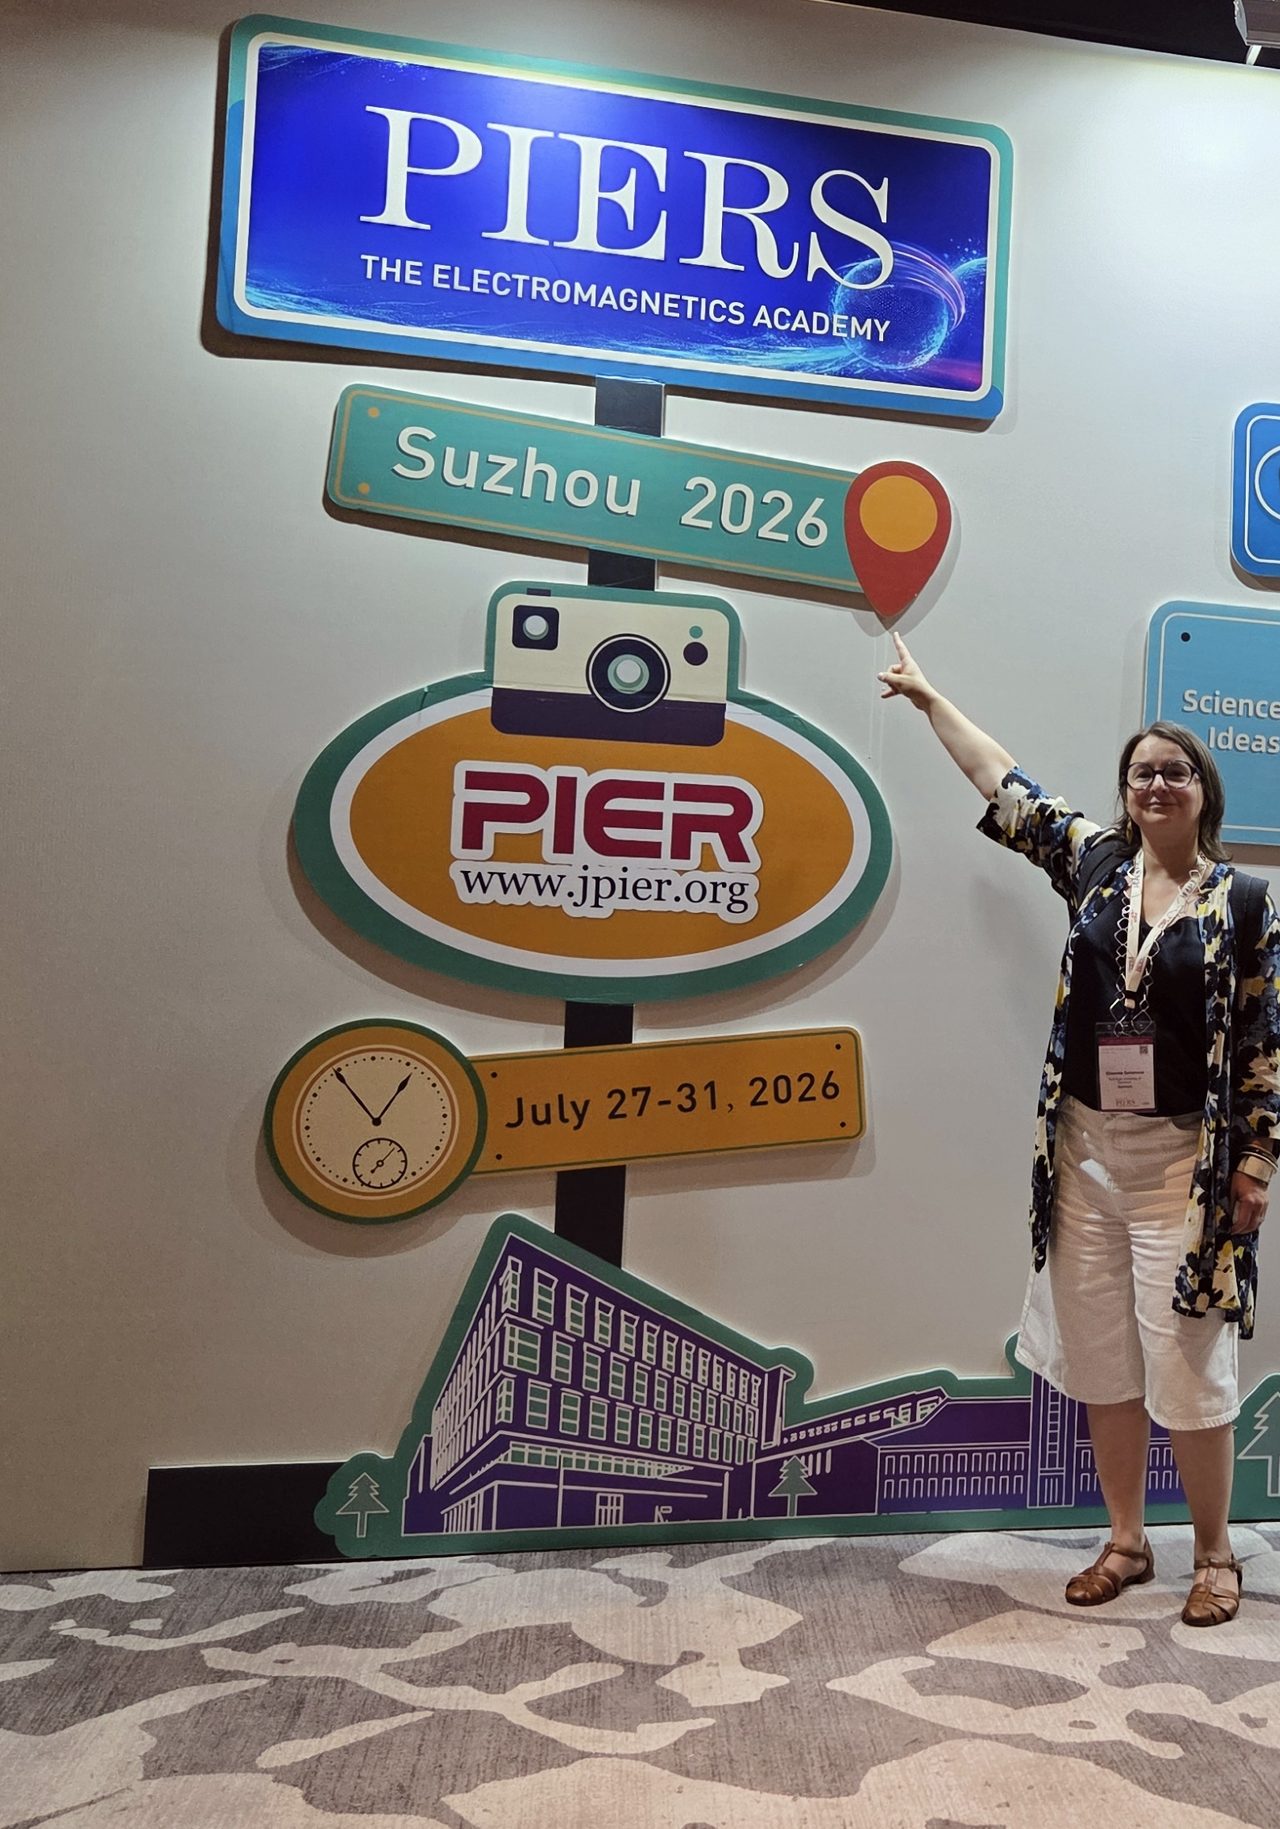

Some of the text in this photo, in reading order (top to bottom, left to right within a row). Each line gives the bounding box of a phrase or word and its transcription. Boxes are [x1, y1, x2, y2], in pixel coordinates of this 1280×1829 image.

[359, 104, 896, 291] PIERS
[361, 254, 891, 343] THE ELECTROMAGNETICS ACADEMY
[392, 426, 829, 548] Suzhou 2026
[1208, 727, 1280, 754] Ideas
[460, 770, 755, 863] PIER
[460, 864, 750, 914] www.jpier.org
[505, 1070, 841, 1130] July 27-31, 2026
